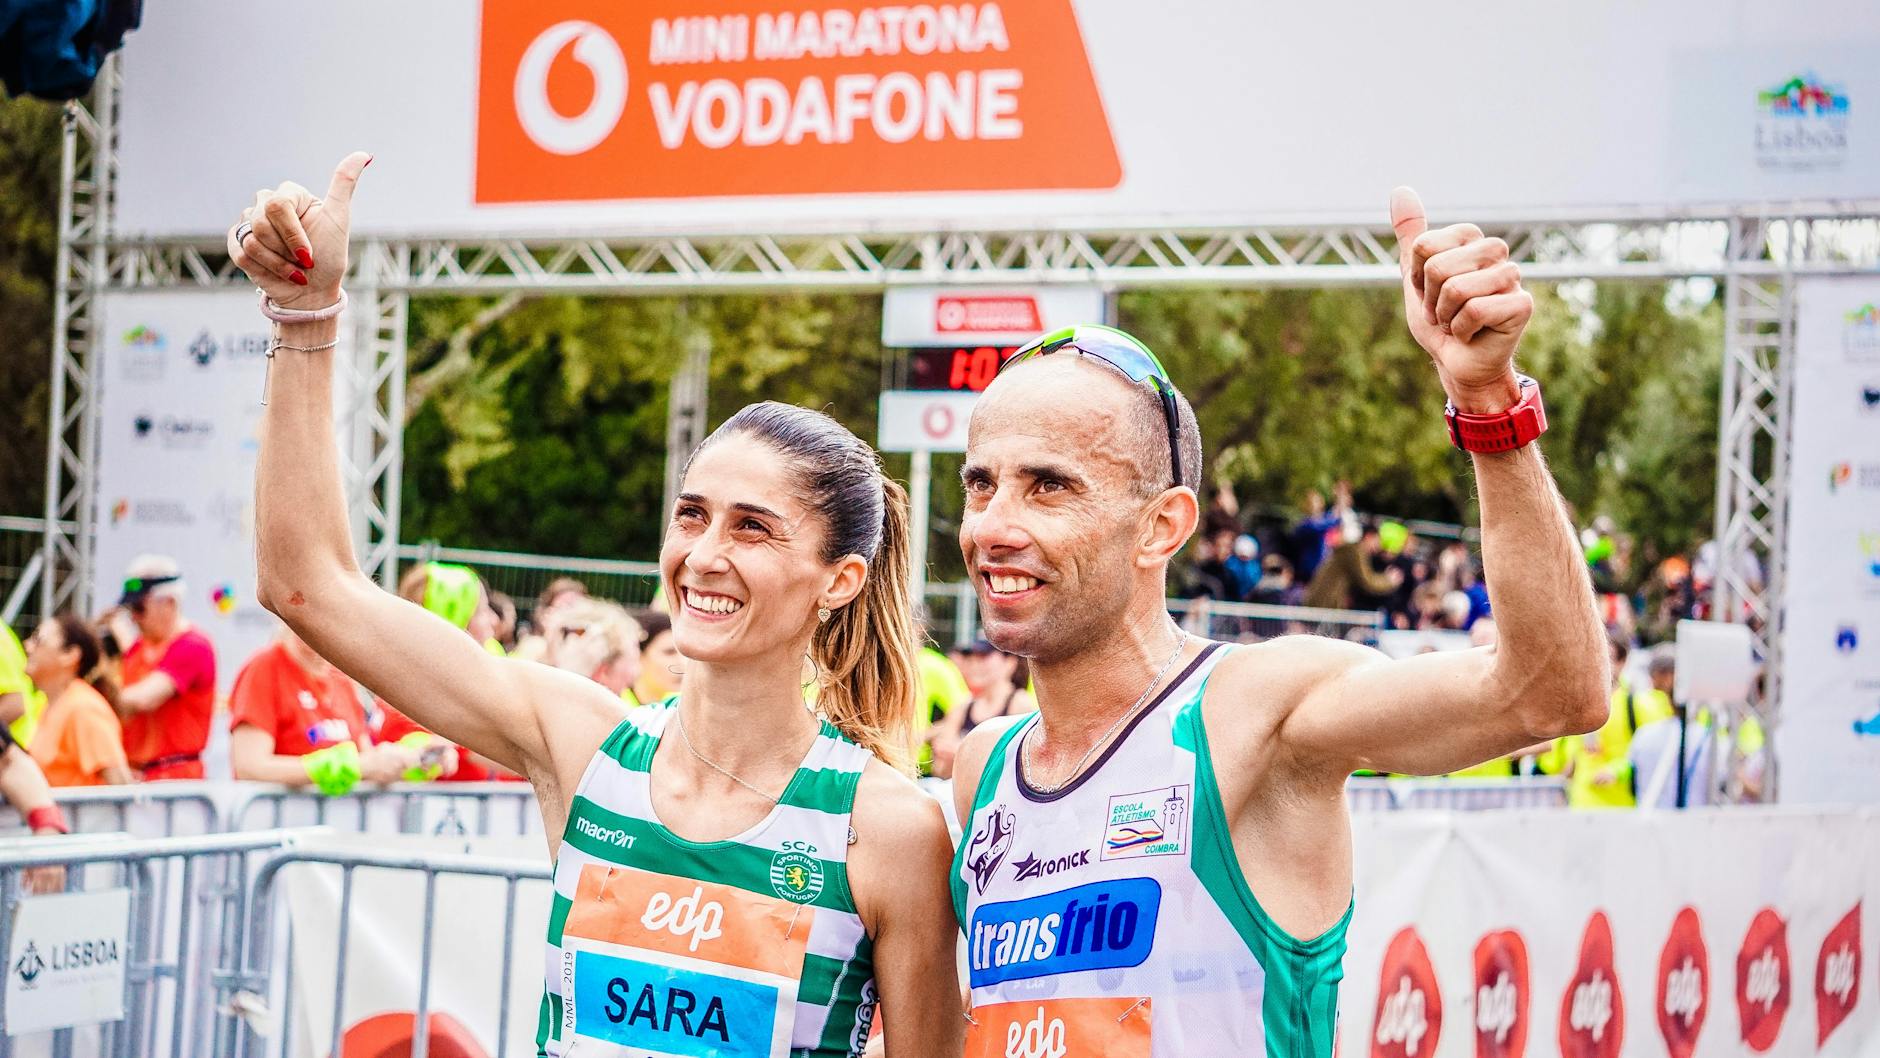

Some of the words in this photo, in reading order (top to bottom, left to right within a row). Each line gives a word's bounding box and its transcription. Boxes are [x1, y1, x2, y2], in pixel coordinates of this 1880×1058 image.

[649, 13, 750, 65] MINI
[753, 2, 1011, 60] MARATONA
[647, 68, 1024, 150] VODAFONE
[1112, 810, 1156, 823] ATLETISMO
[1113, 802, 1143, 814] ESCOLA
[576, 816, 637, 849] macron
[782, 841, 817, 853] SCP
[1144, 843, 1179, 854] COIMBRA
[777, 855, 818, 872] SPORTING
[777, 887, 816, 900] PORTUGAL
[641, 886, 724, 952] edp
[973, 893, 1139, 970] transfrio
[52, 939, 118, 970] LISBOA
[563, 951, 574, 984] 2019
[565, 996, 575, 1029] MML
[604, 977, 729, 1042] SARA
